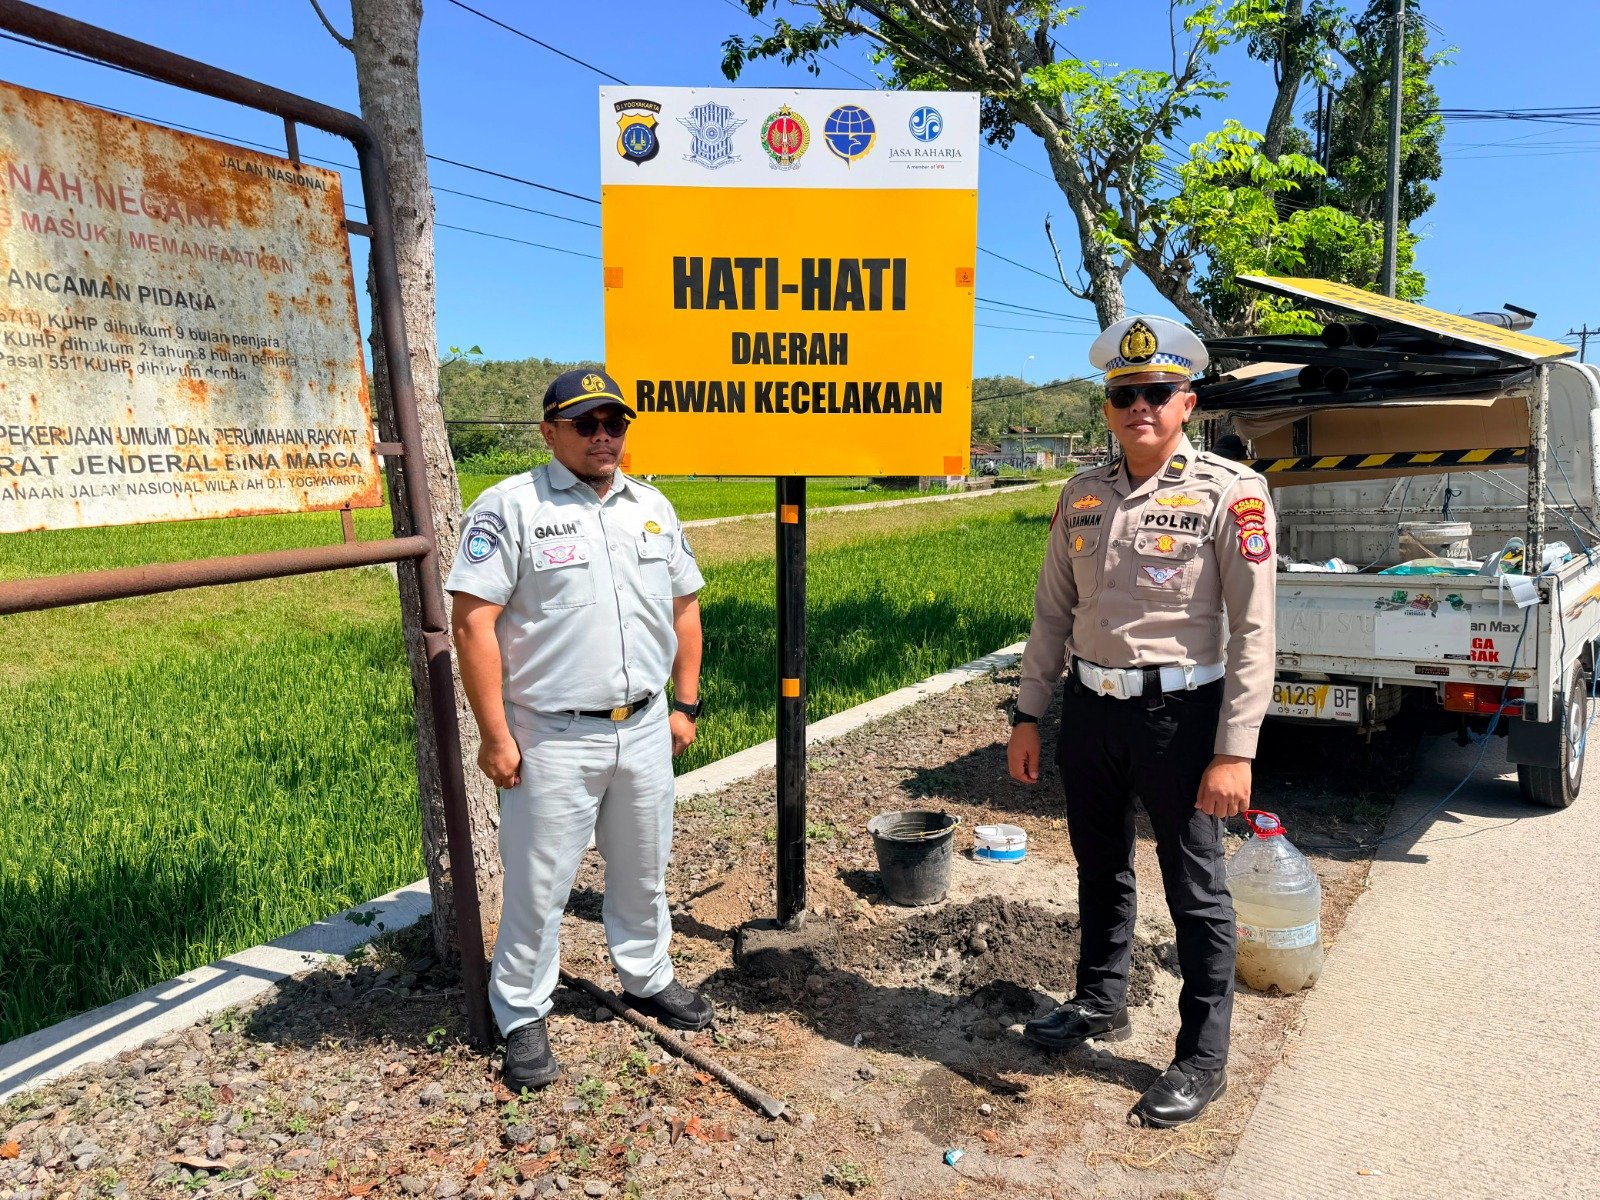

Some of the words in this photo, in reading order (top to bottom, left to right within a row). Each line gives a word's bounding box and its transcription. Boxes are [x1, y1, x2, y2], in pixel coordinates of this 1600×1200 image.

[888, 148, 911, 158] JASA
[914, 148, 962, 158] RAHARJA
[219, 155, 263, 176] JALAN
[266, 166, 330, 192] NASIONAL
[93, 173, 229, 232] NEGARA
[21, 210, 111, 247] MASUK
[128, 230, 295, 274] MEMANFAATKAN
[7, 268, 132, 302] ANCAMAN
[138, 285, 217, 311] PIDANA
[672, 255, 907, 311] HATI-HATI
[48, 313, 98, 332] KUHP
[103, 319, 172, 339] dihukum
[176, 325, 185, 340] 9
[188, 328, 231, 344] bulan
[232, 334, 280, 350] penjara
[4, 330, 57, 349] KUHP
[62, 336, 135, 355] dihukum
[139, 342, 149, 356] 2
[152, 344, 194, 360] tahun
[198, 347, 207, 360] 8
[252, 353, 298, 368] penjara
[731, 332, 849, 366] DAERAH
[49, 355, 78, 371] 551
[85, 357, 131, 373] KUHP
[635, 379, 746, 414] RAWAN
[754, 381, 943, 414] KECELAKAAN
[117, 426, 172, 446] UMUM
[175, 427, 211, 446] DAN
[308, 428, 358, 445] RAKYAT
[0, 454, 60, 477] RAT
[70, 453, 218, 476] JENDERAL
[225, 452, 282, 472] BINA
[286, 451, 363, 470] MARGA
[1, 485, 65, 501] ANAAN
[127, 480, 202, 496] NASIONAL
[287, 474, 366, 488] YOGYAKARTA
[533, 522, 578, 539] GALIH
[1143, 513, 1199, 531] POLRI
[1489, 620, 1520, 633] Max
[1472, 637, 1495, 650] GA
[1272, 684, 1317, 706] 8126
[1333, 688, 1356, 708] BF
